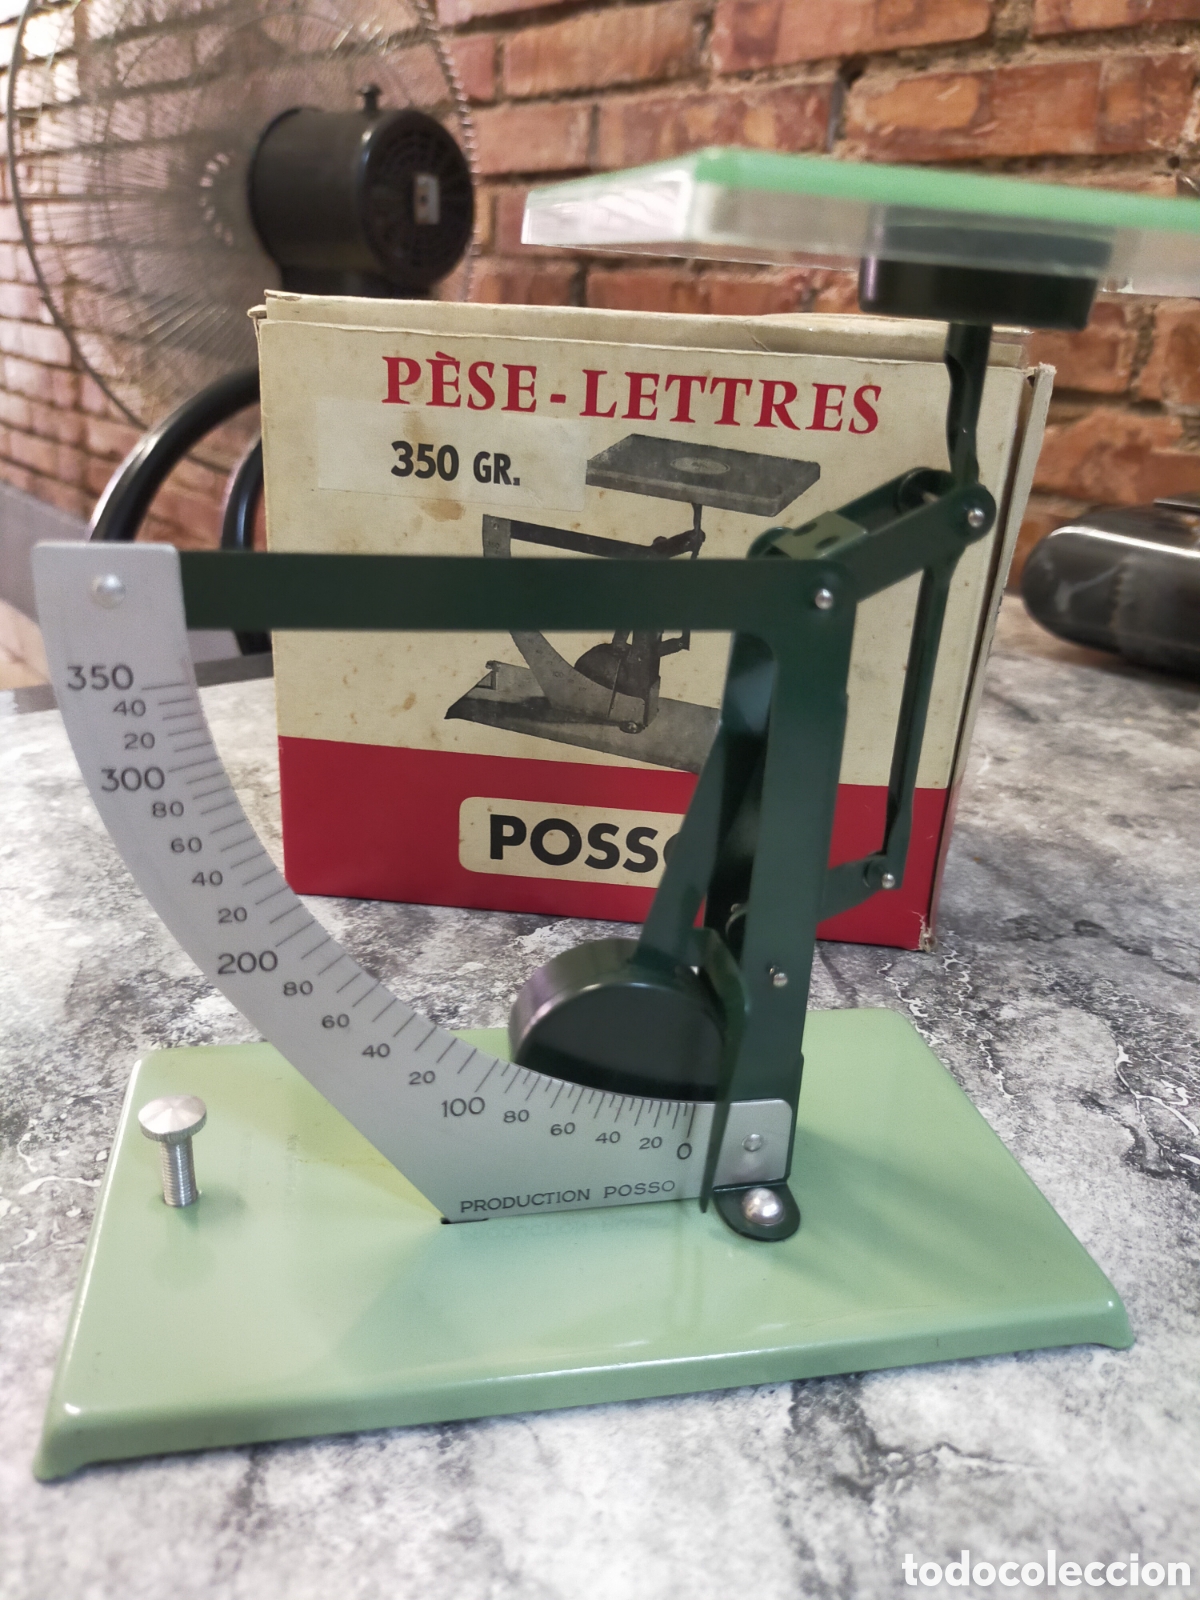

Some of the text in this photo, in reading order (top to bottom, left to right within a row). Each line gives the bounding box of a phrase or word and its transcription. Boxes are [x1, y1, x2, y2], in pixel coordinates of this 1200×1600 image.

[391, 440, 521, 486] 350 GR.
[67, 664, 134, 690] 350
[112, 700, 147, 717] 40
[124, 732, 156, 750] 20
[101, 767, 165, 791] 300
[152, 801, 185, 818] 80
[170, 837, 203, 853] 60
[490, 814, 683, 873] POSS
[192, 871, 223, 887] 40
[217, 907, 248, 924] 20
[217, 950, 278, 975] 200
[283, 980, 314, 996] 80
[321, 1014, 350, 1029] 60
[362, 1043, 391, 1058] 40
[408, 1070, 436, 1085] 20
[441, 1096, 486, 1118] 100
[503, 1109, 530, 1123] 80
[550, 1122, 576, 1136] 60
[595, 1131, 621, 1144] 40
[638, 1136, 663, 1150] 20
[676, 1142, 692, 1160] 0
[460, 1180, 676, 1213] PRODUCTION POSSO
